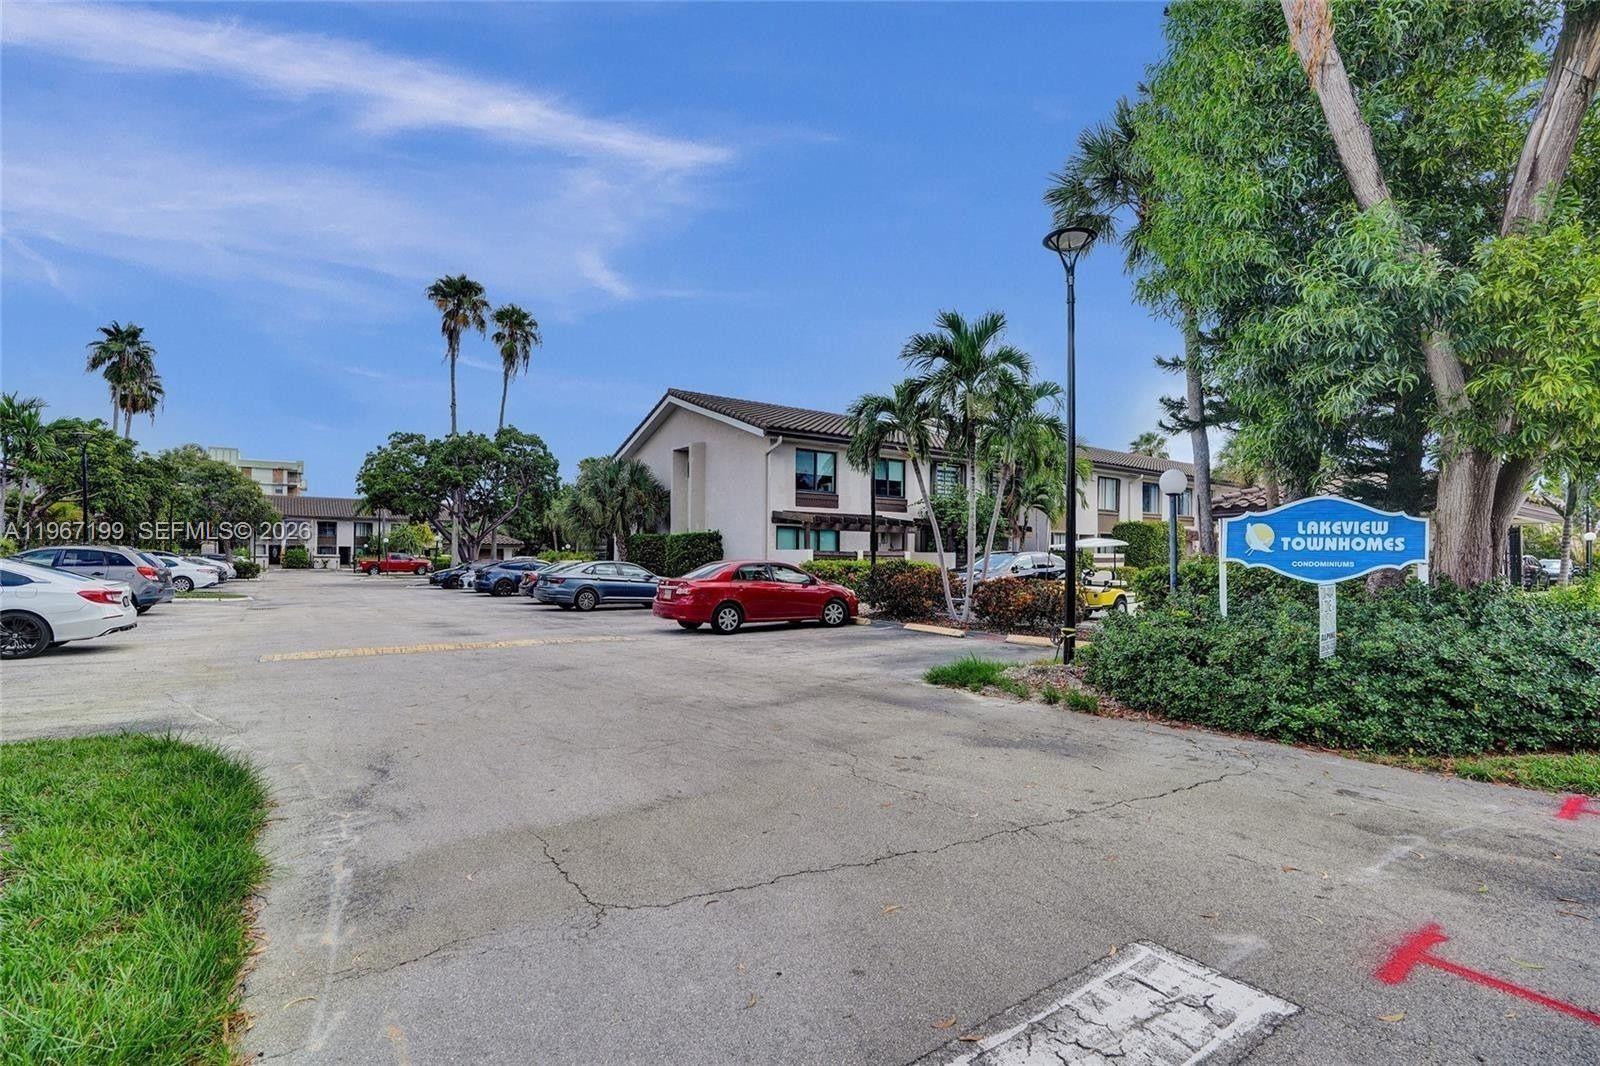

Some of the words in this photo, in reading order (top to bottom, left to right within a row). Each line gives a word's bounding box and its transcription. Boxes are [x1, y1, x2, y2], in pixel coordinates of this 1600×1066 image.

[1297, 521, 1389, 535] LAKEVIEW
[1281, 537, 1405, 551] TOWNHOMES
[1291, 560, 1355, 568] CONDOMINIUMS
